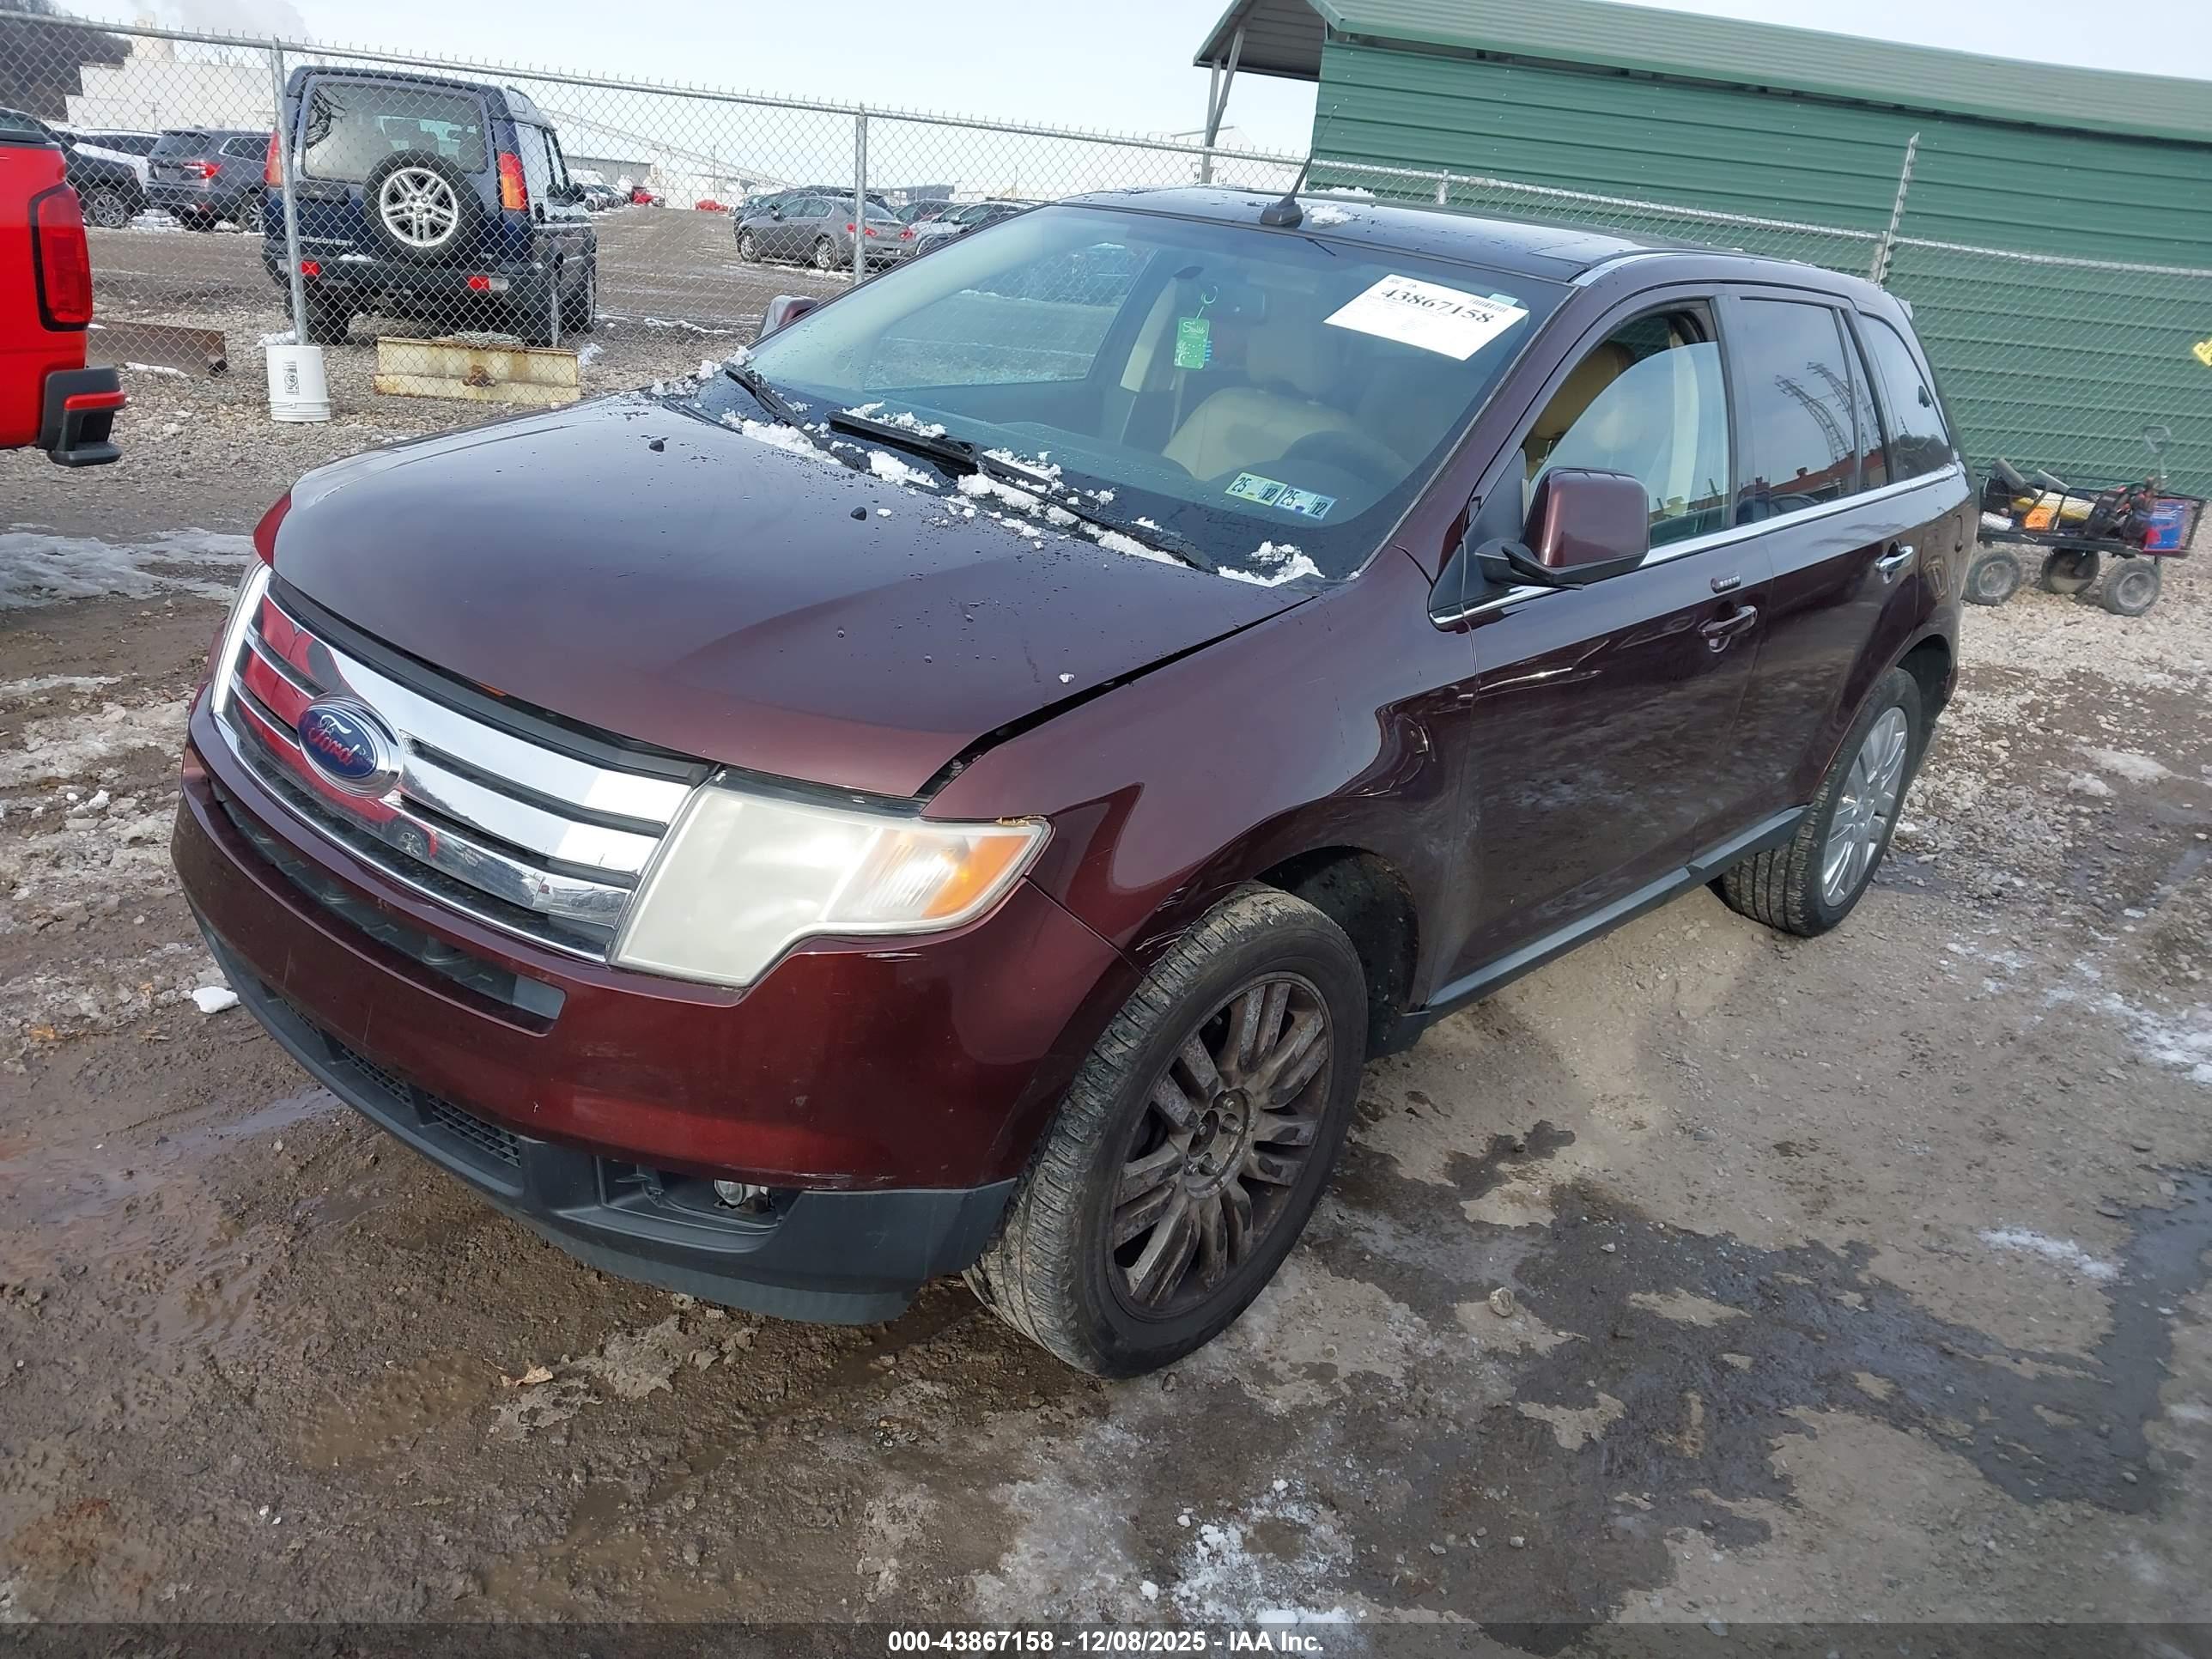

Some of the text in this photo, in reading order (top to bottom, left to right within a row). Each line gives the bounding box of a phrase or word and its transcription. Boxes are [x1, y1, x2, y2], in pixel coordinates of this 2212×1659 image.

[298, 235, 353, 246] DISCOVERY
[1381, 289, 1494, 323] 43867158
[1231, 477, 1279, 501] 25 12
[1280, 489, 1328, 516] 25 12
[308, 714, 362, 766] Ford
